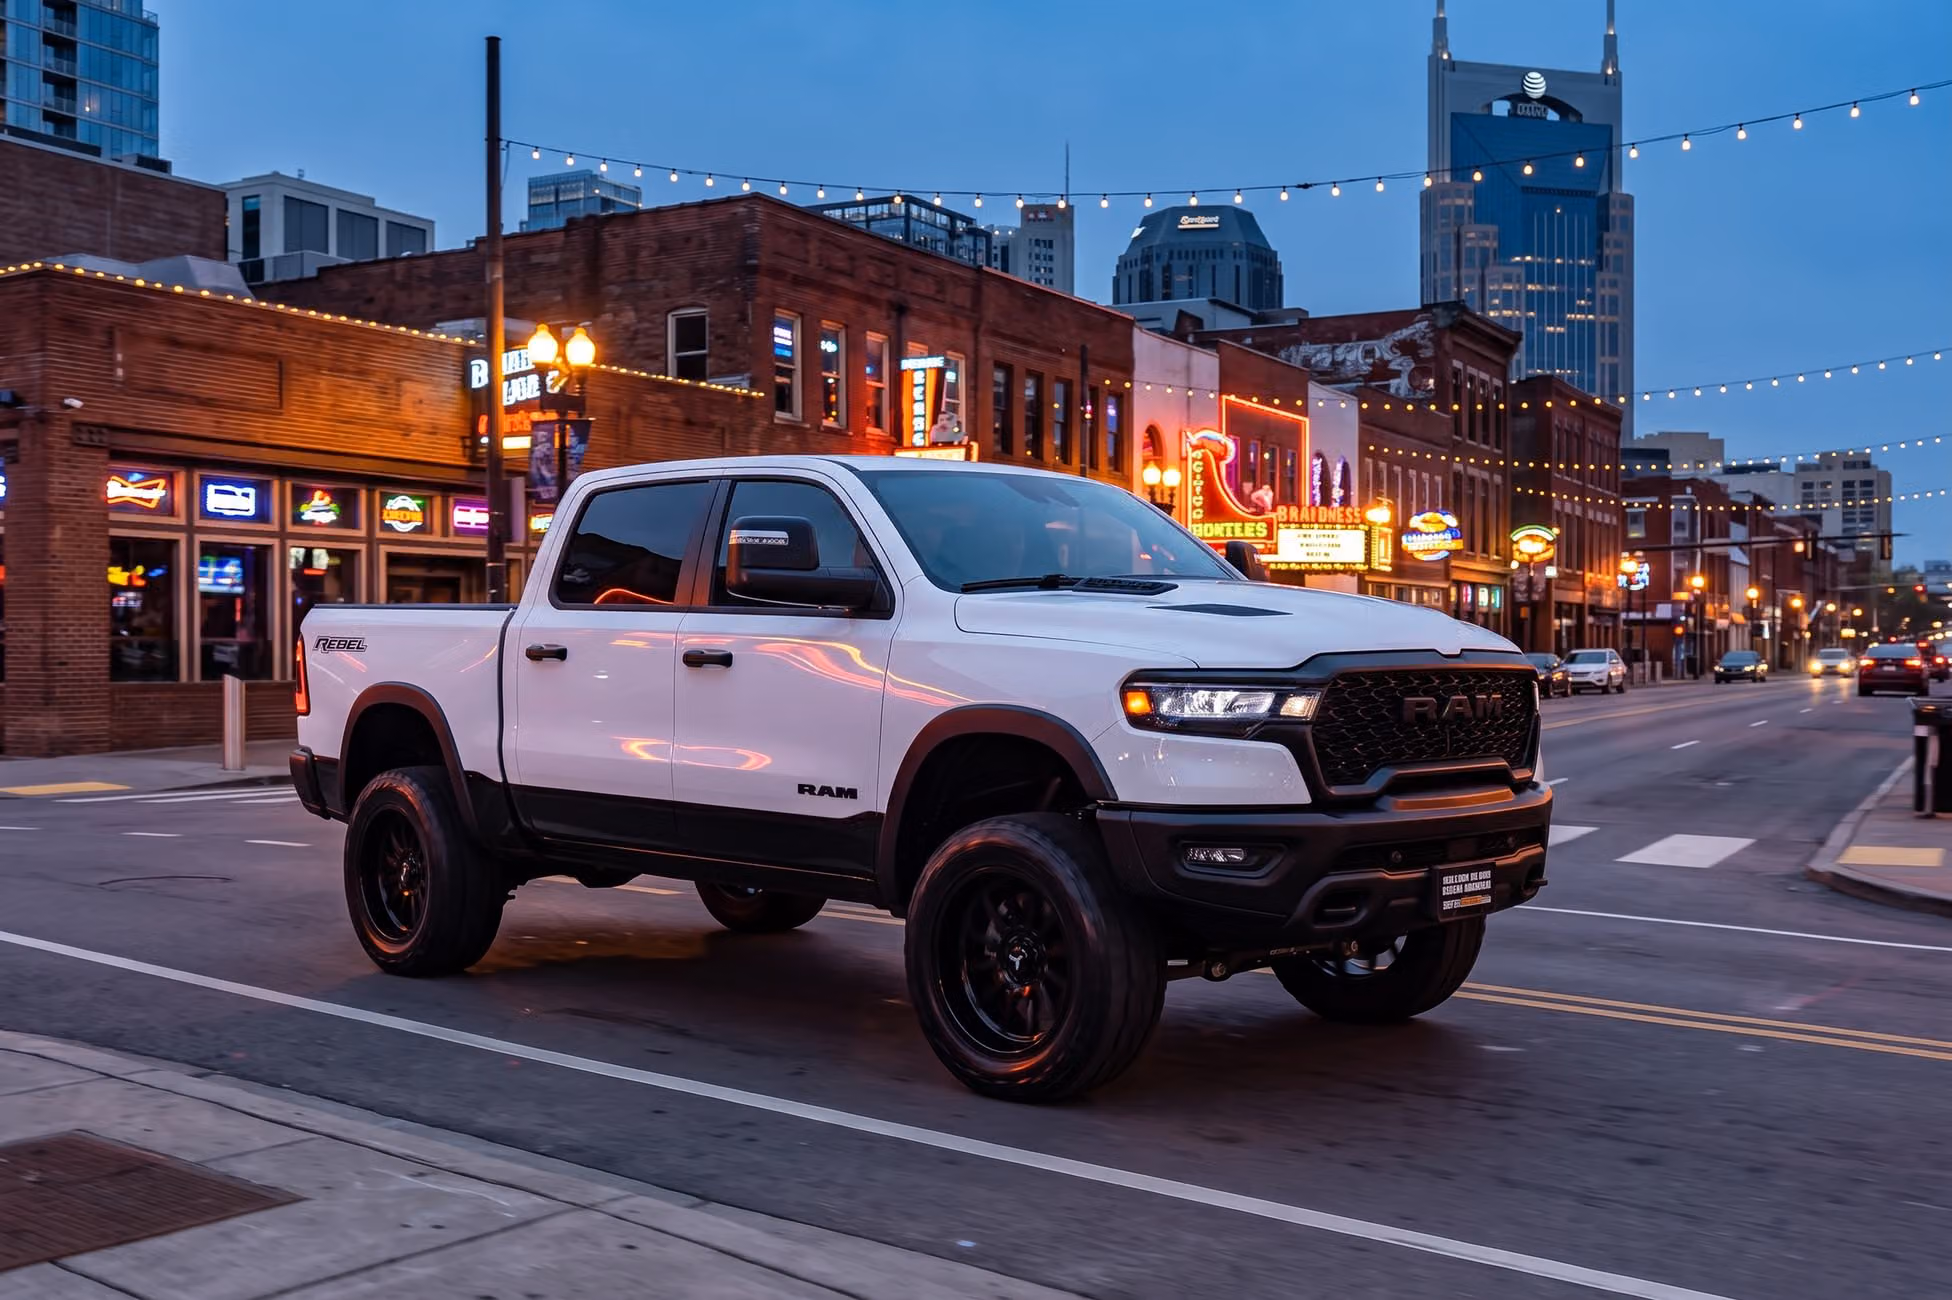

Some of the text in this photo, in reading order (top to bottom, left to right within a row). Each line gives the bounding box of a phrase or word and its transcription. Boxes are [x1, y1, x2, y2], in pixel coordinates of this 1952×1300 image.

[313, 636, 367, 653] REBEL
[1402, 694, 1504, 722] RAM
[798, 784, 858, 799] RAM
